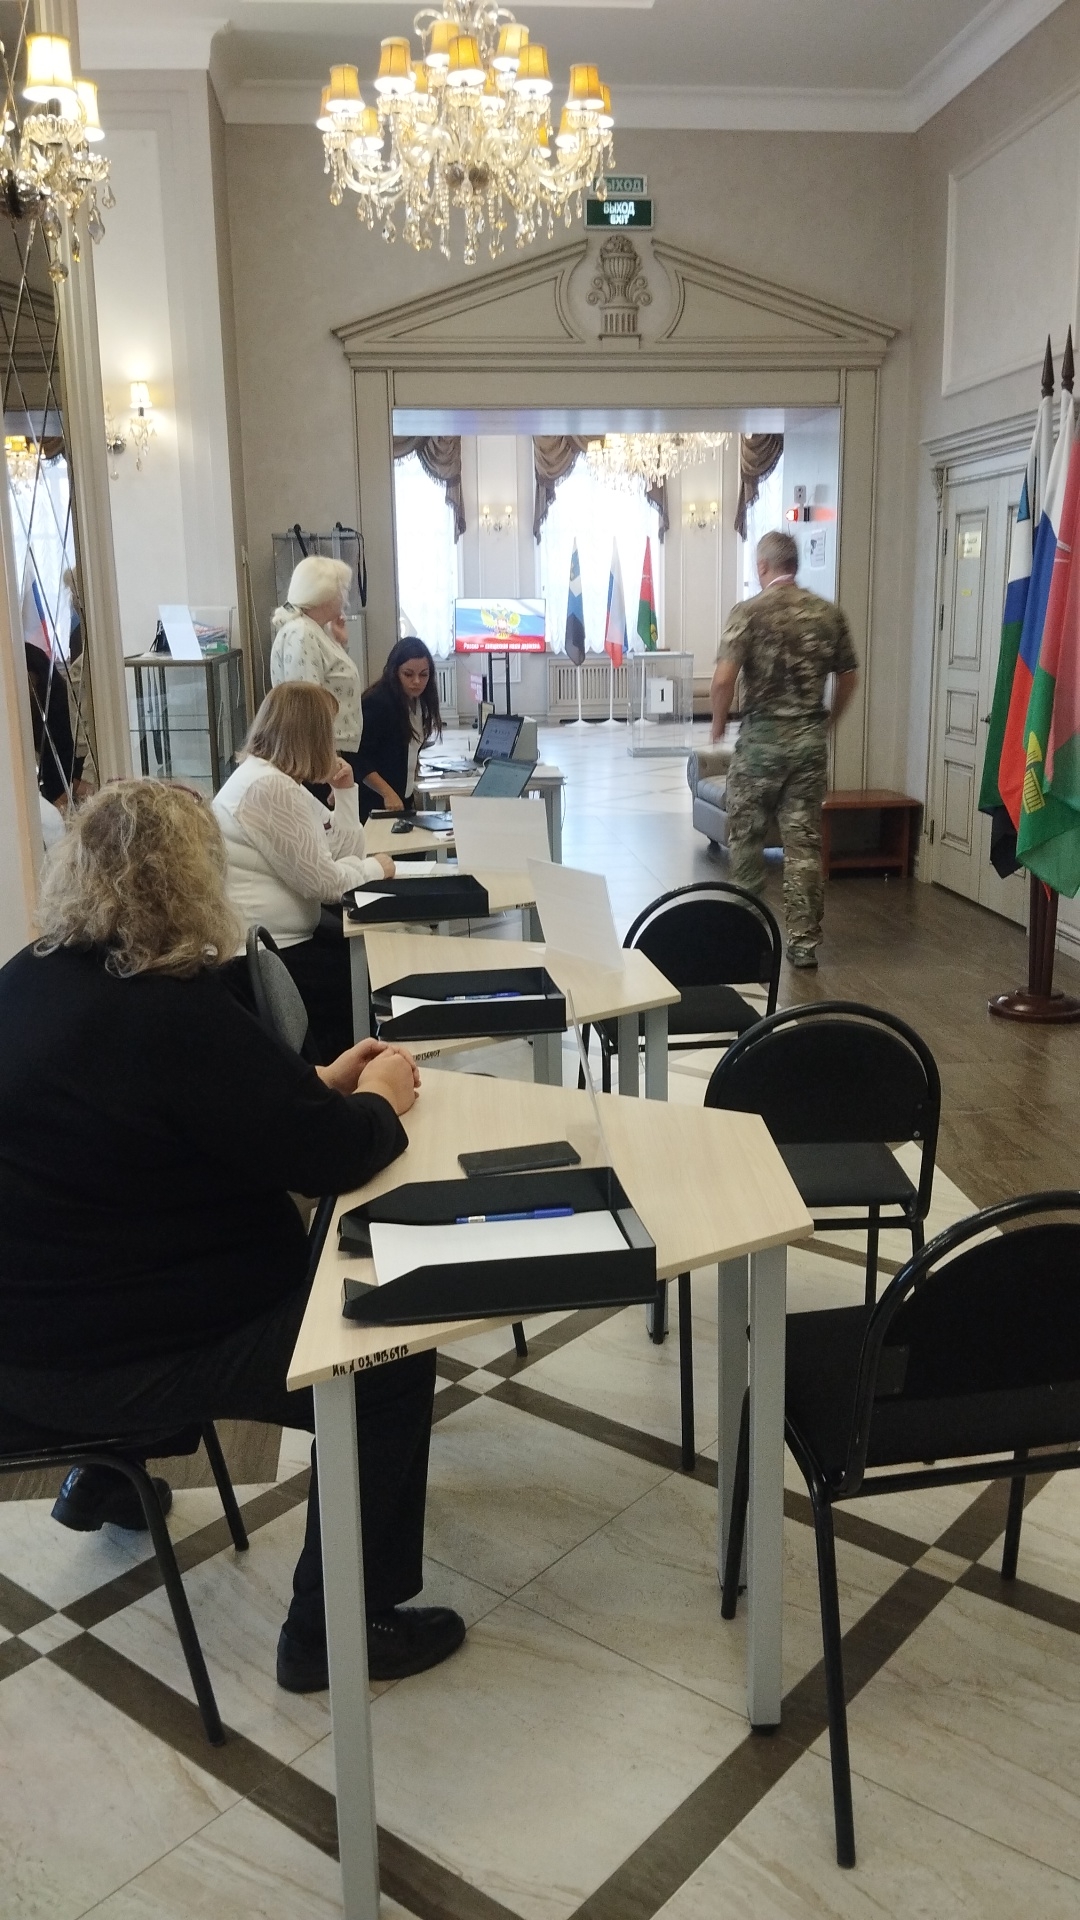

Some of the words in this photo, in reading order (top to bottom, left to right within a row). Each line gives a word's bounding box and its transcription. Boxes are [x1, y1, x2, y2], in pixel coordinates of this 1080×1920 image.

[595, 179, 642, 192] ЫХОД
[603, 201, 635, 216] ВЫХОД
[660, 687, 665, 702] 1
